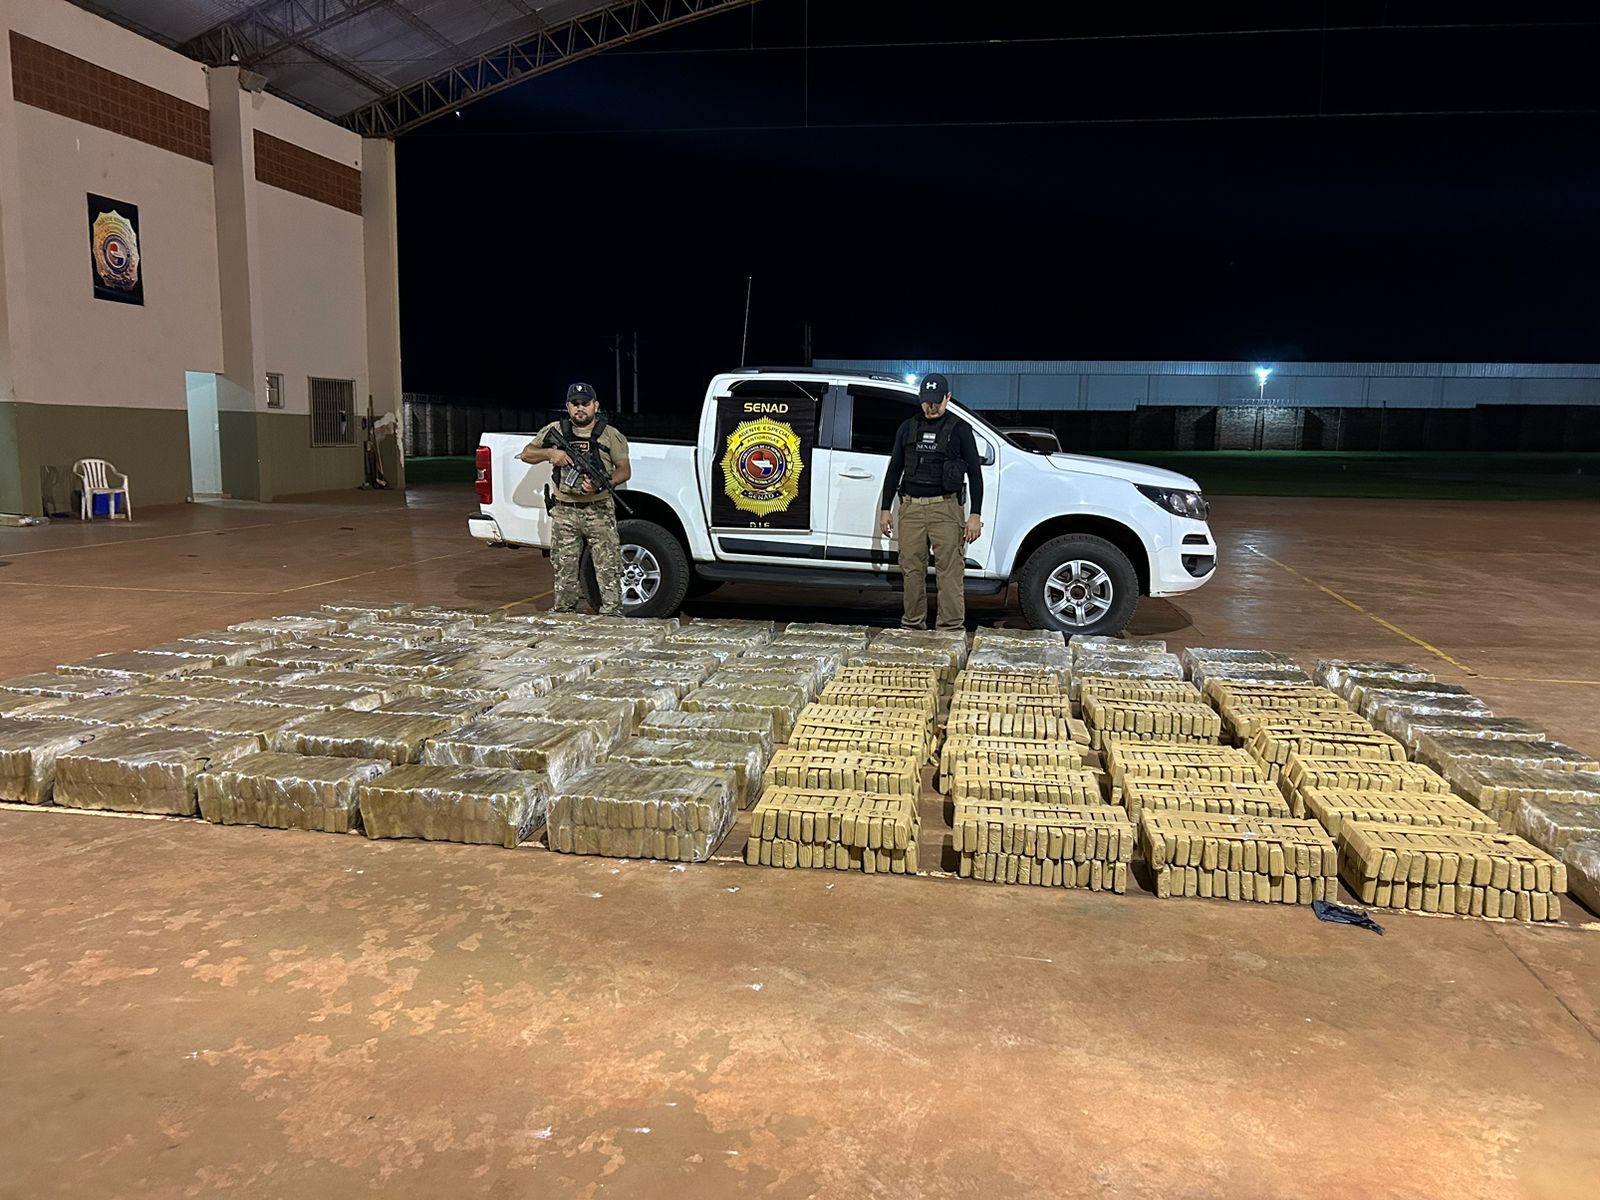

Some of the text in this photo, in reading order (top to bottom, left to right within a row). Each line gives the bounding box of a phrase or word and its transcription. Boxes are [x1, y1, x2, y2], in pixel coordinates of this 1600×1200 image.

[744, 402, 789, 413] SENAD
[738, 425, 790, 439] AGENTE ESPECIAL
[748, 492, 775, 500] SENAD
